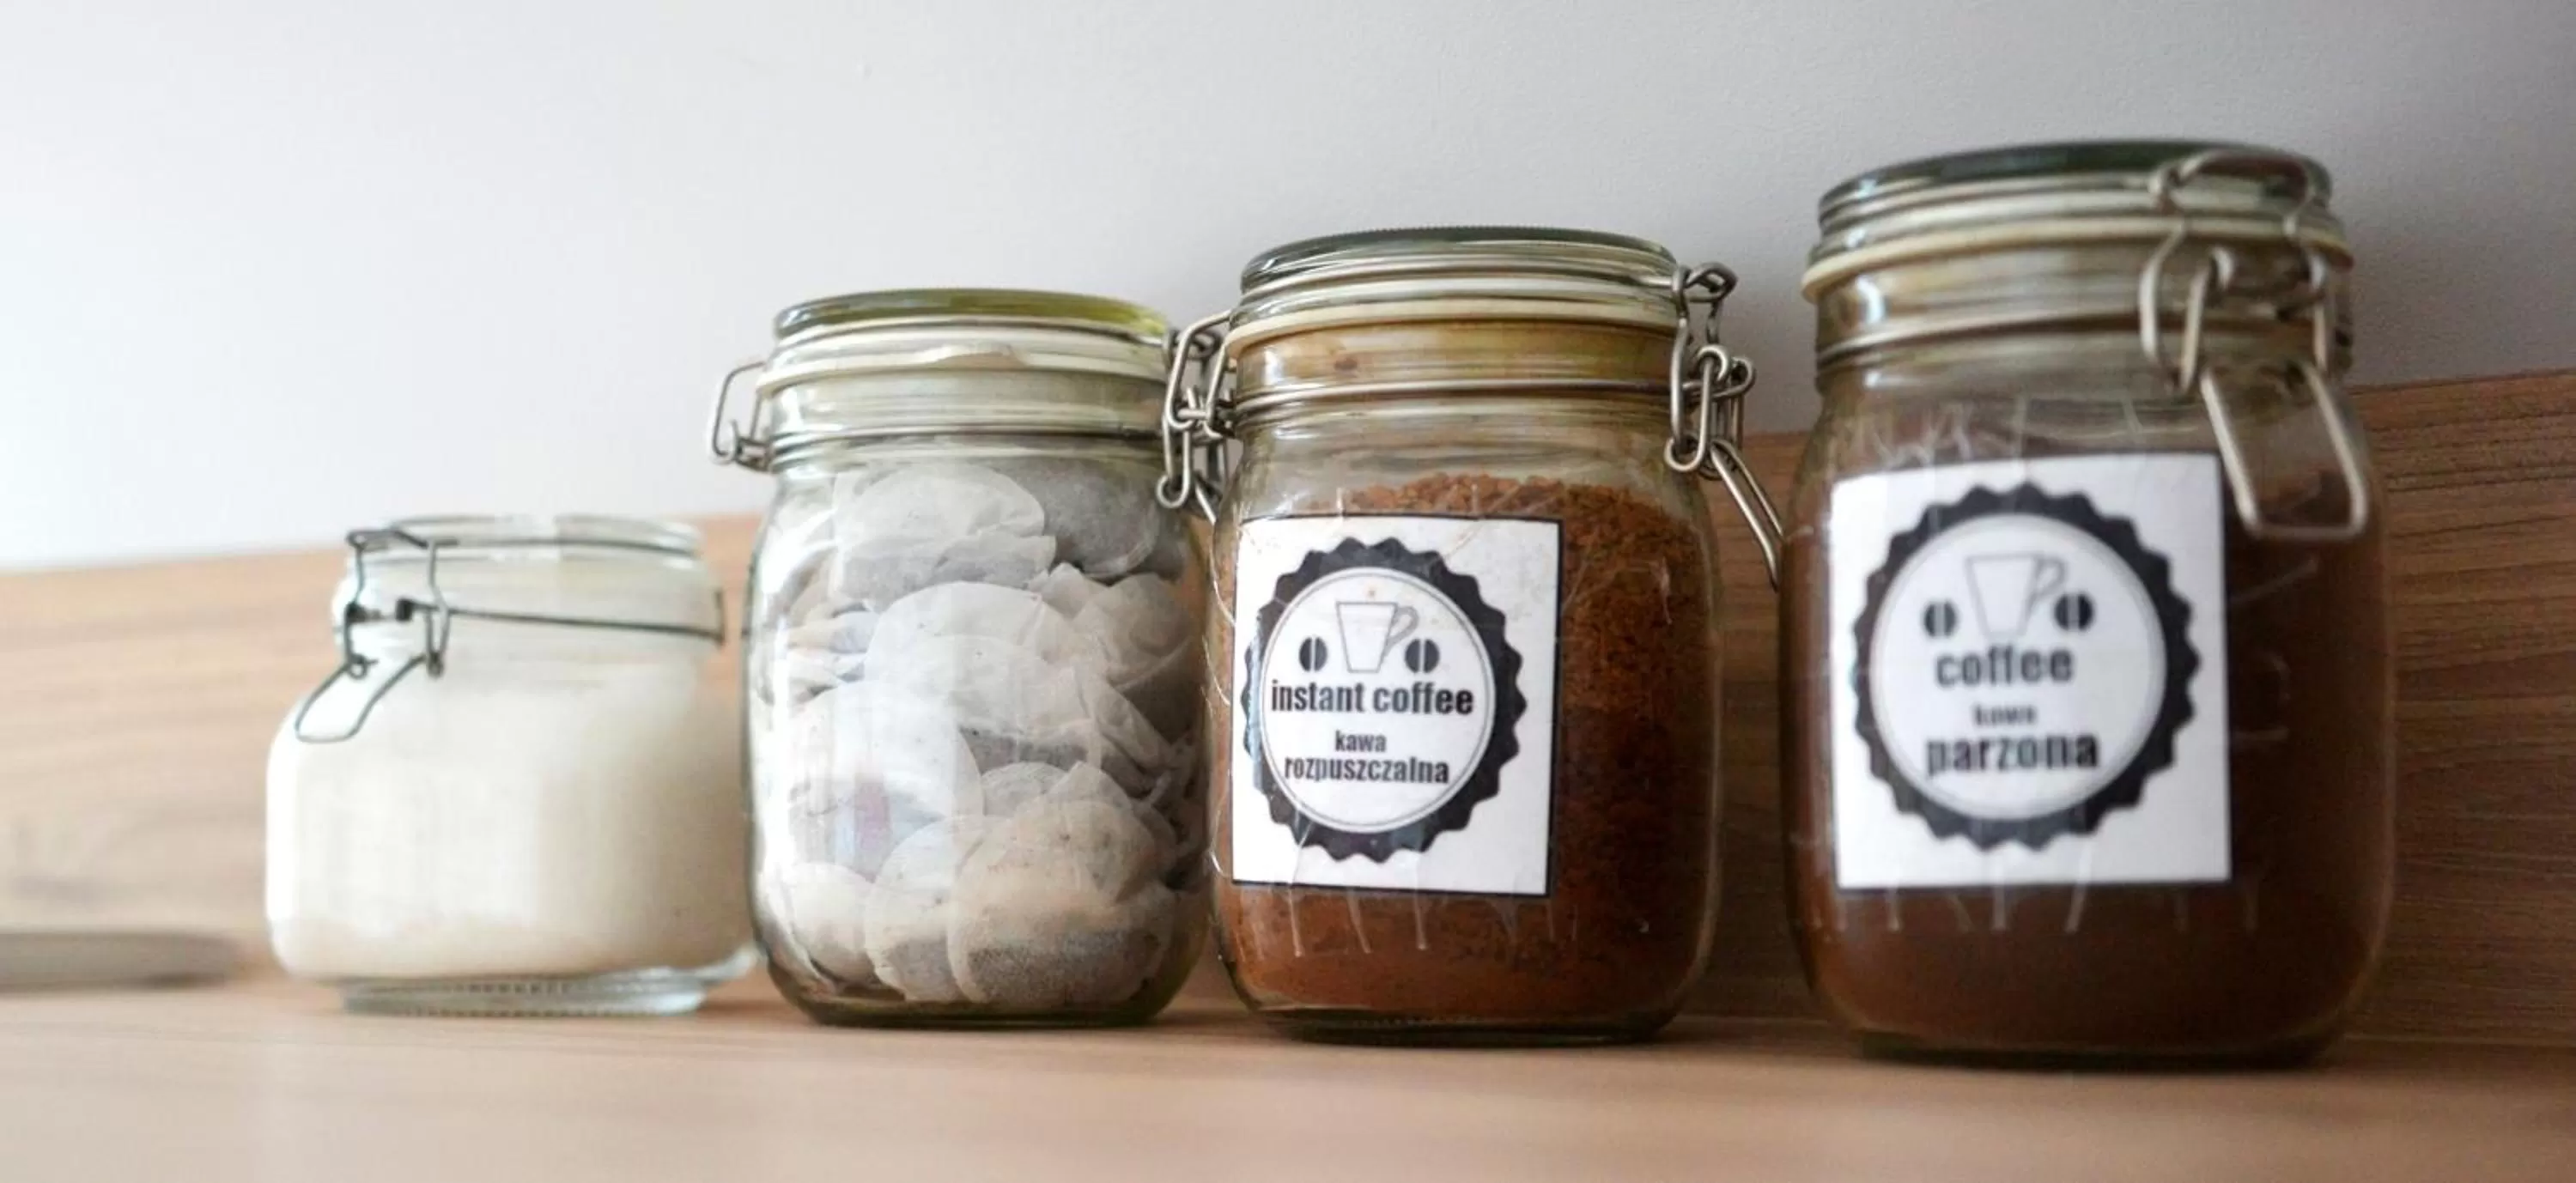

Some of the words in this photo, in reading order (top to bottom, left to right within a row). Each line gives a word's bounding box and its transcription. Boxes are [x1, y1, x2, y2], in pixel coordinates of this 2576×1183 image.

[1935, 645, 2074, 686] coffee
[1271, 679, 1366, 713] instant
[1371, 682, 1474, 715] coffee
[1334, 731, 1387, 752] kawa
[1926, 733, 2099, 778] parzona
[1284, 756, 1450, 784] rozpuszczalna
